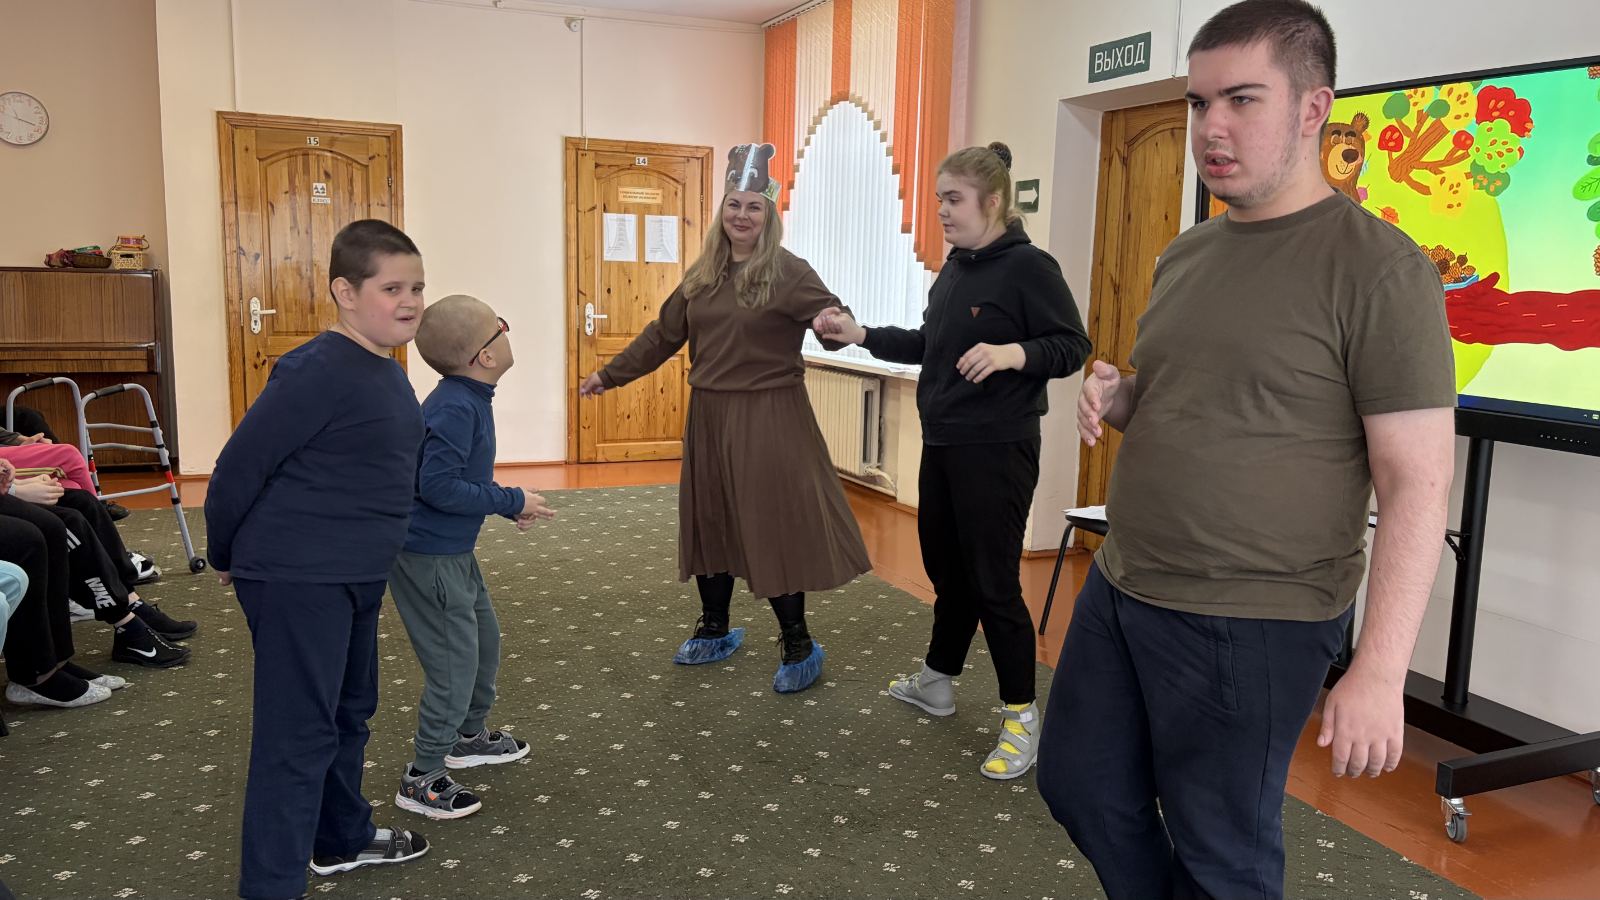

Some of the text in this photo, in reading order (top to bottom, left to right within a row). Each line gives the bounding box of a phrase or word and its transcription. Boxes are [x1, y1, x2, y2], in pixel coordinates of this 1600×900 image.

[1094, 41, 1145, 74] ВЫХОД
[308, 137, 319, 145] 15
[84, 576, 117, 609] NIKE
